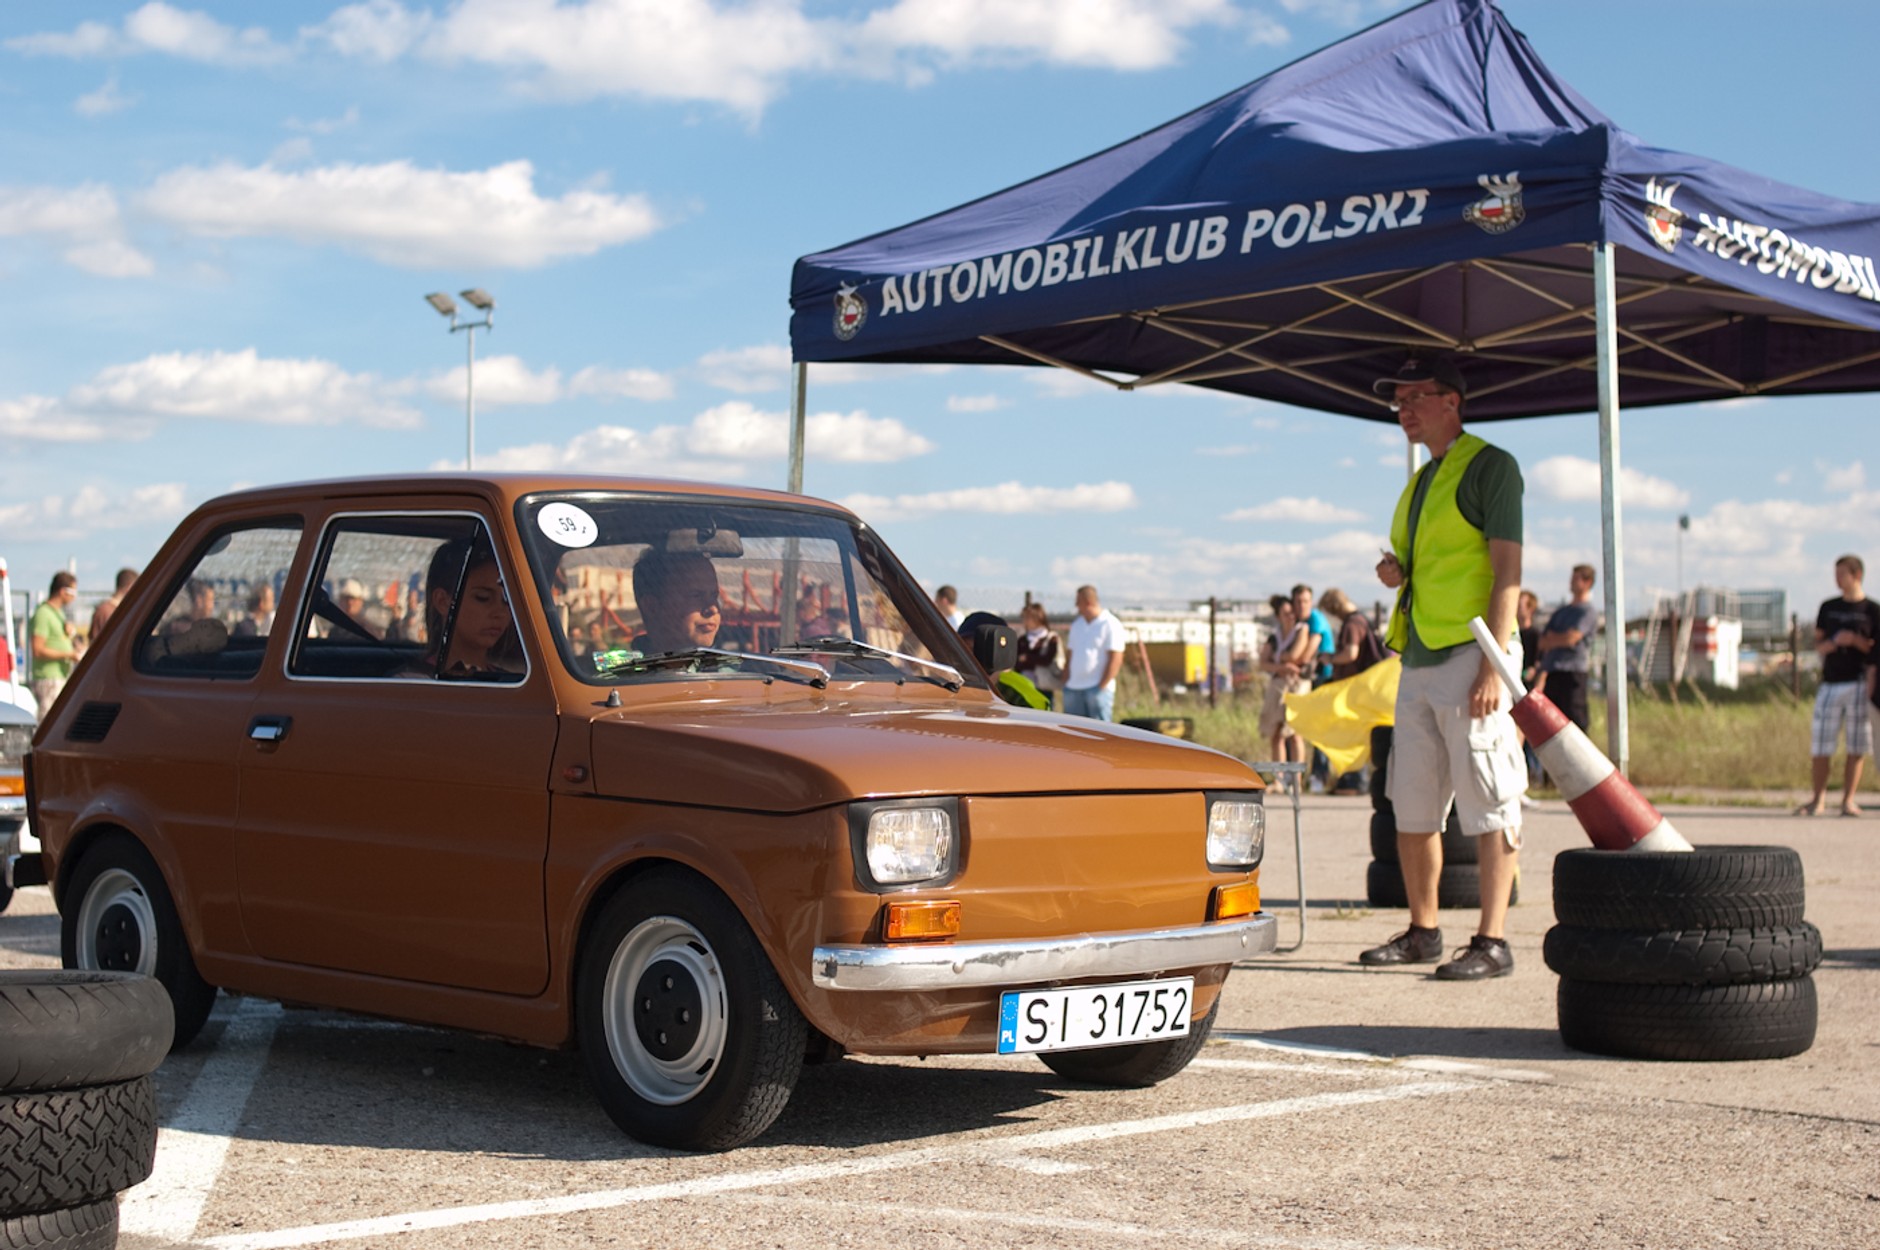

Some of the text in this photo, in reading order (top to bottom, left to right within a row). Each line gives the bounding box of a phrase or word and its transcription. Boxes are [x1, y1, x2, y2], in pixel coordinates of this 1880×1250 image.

[880, 216, 1229, 317] AUTOMOBILKLUB
[558, 516, 577, 532] 59
[1025, 987, 1187, 1044] SI 31752
[1001, 1030, 1015, 1043] PL
